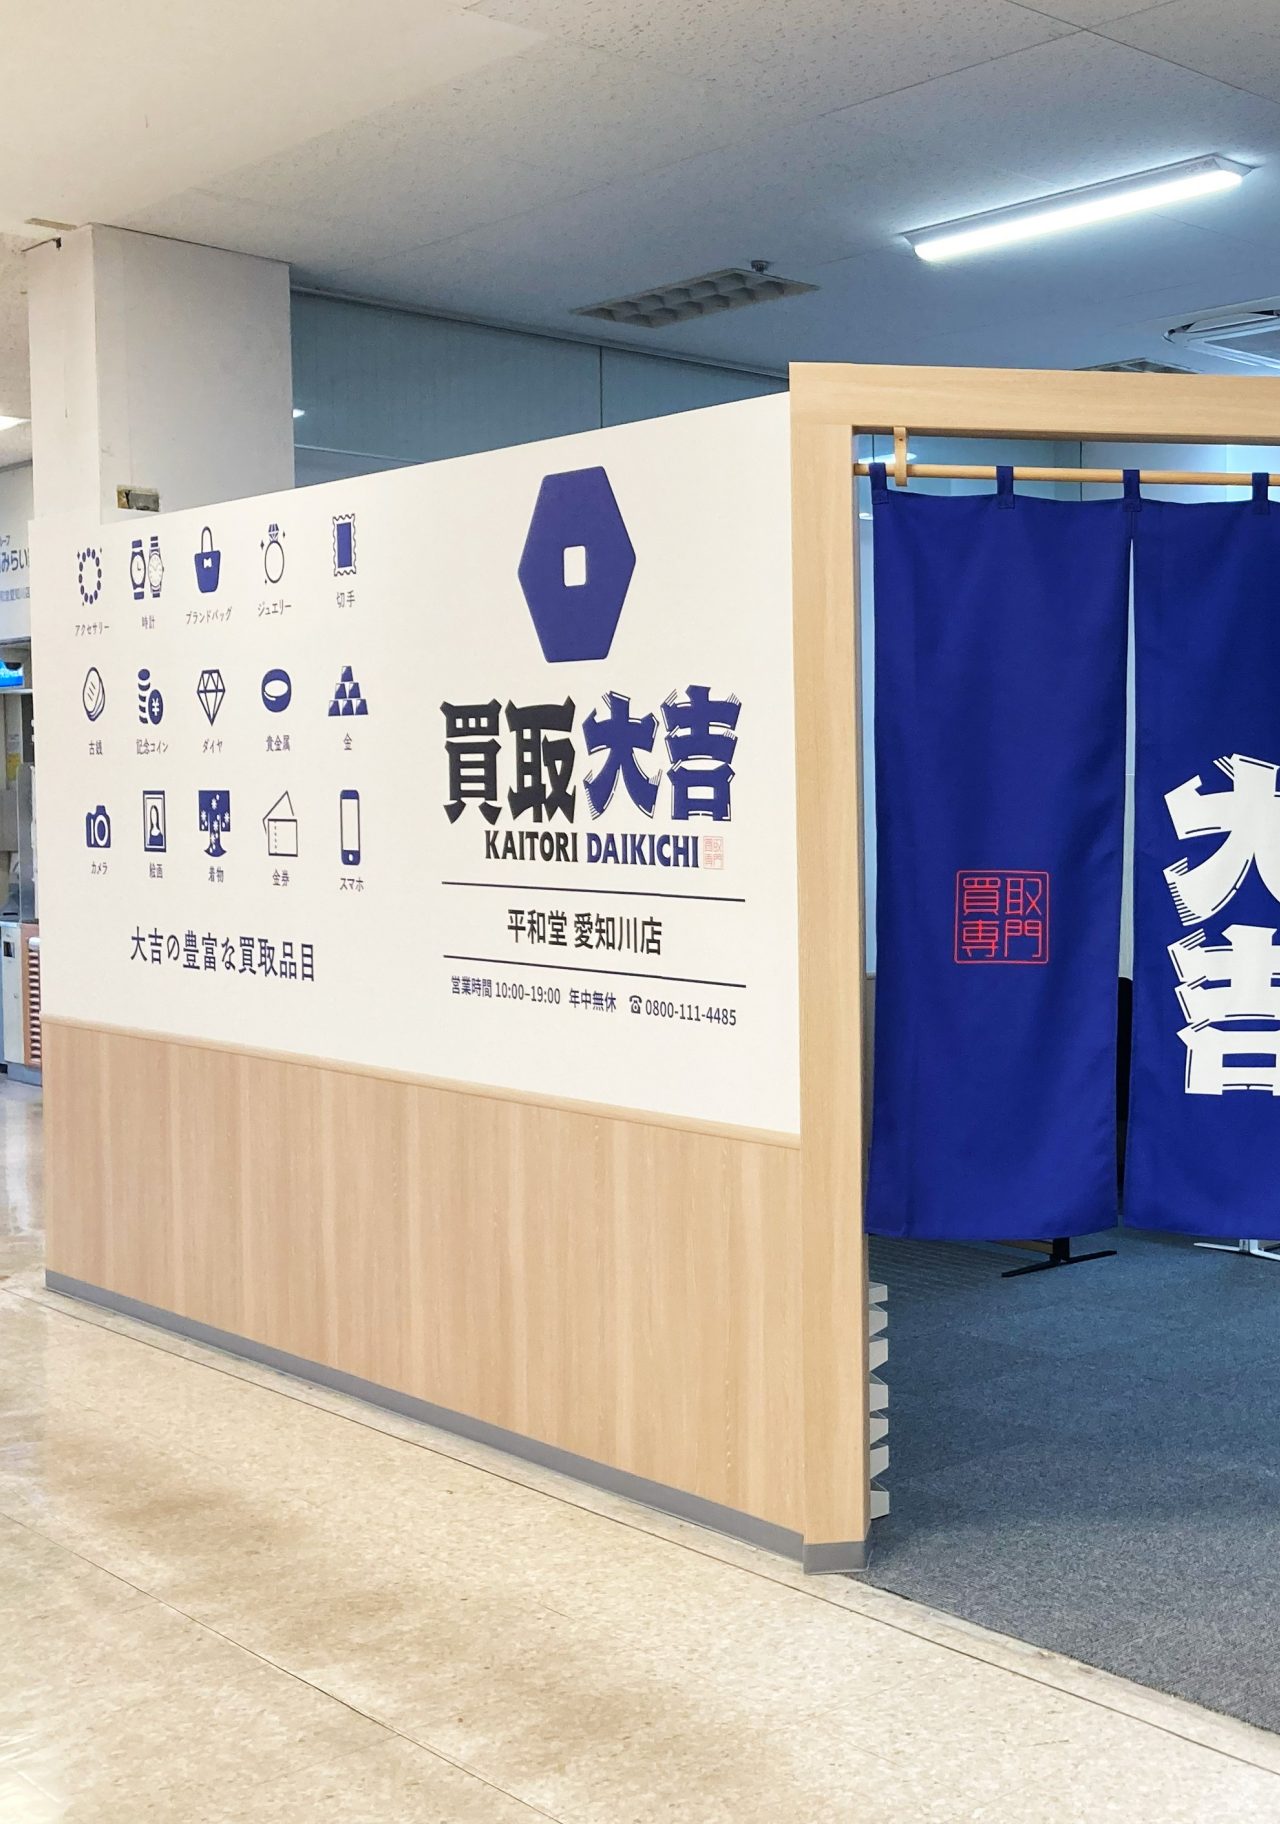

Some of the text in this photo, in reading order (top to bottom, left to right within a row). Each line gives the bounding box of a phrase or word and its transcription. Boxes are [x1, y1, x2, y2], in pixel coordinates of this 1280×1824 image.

[258, 600, 292, 616] ジュエリー
[336, 590, 355, 608] 切手
[186, 606, 232, 625] ブランドバッグ
[75, 621, 110, 637] アクセサリー
[203, 739, 223, 754] ダイヤ
[343, 732, 352, 750] 金
[440, 685, 742, 825] 買取大吉
[485, 830, 700, 868] KAITORI DAIKICHI
[91, 861, 108, 875] カメラ
[339, 876, 364, 892] スマホ
[507, 909, 662, 955] 平和堂 愛知川店
[131, 925, 315, 982] 大吉の豊富な買取品目
[451, 976, 492, 998] 営業時間
[568, 987, 617, 1013] 年中無休
[645, 999, 737, 1027] 0800-111-4485
